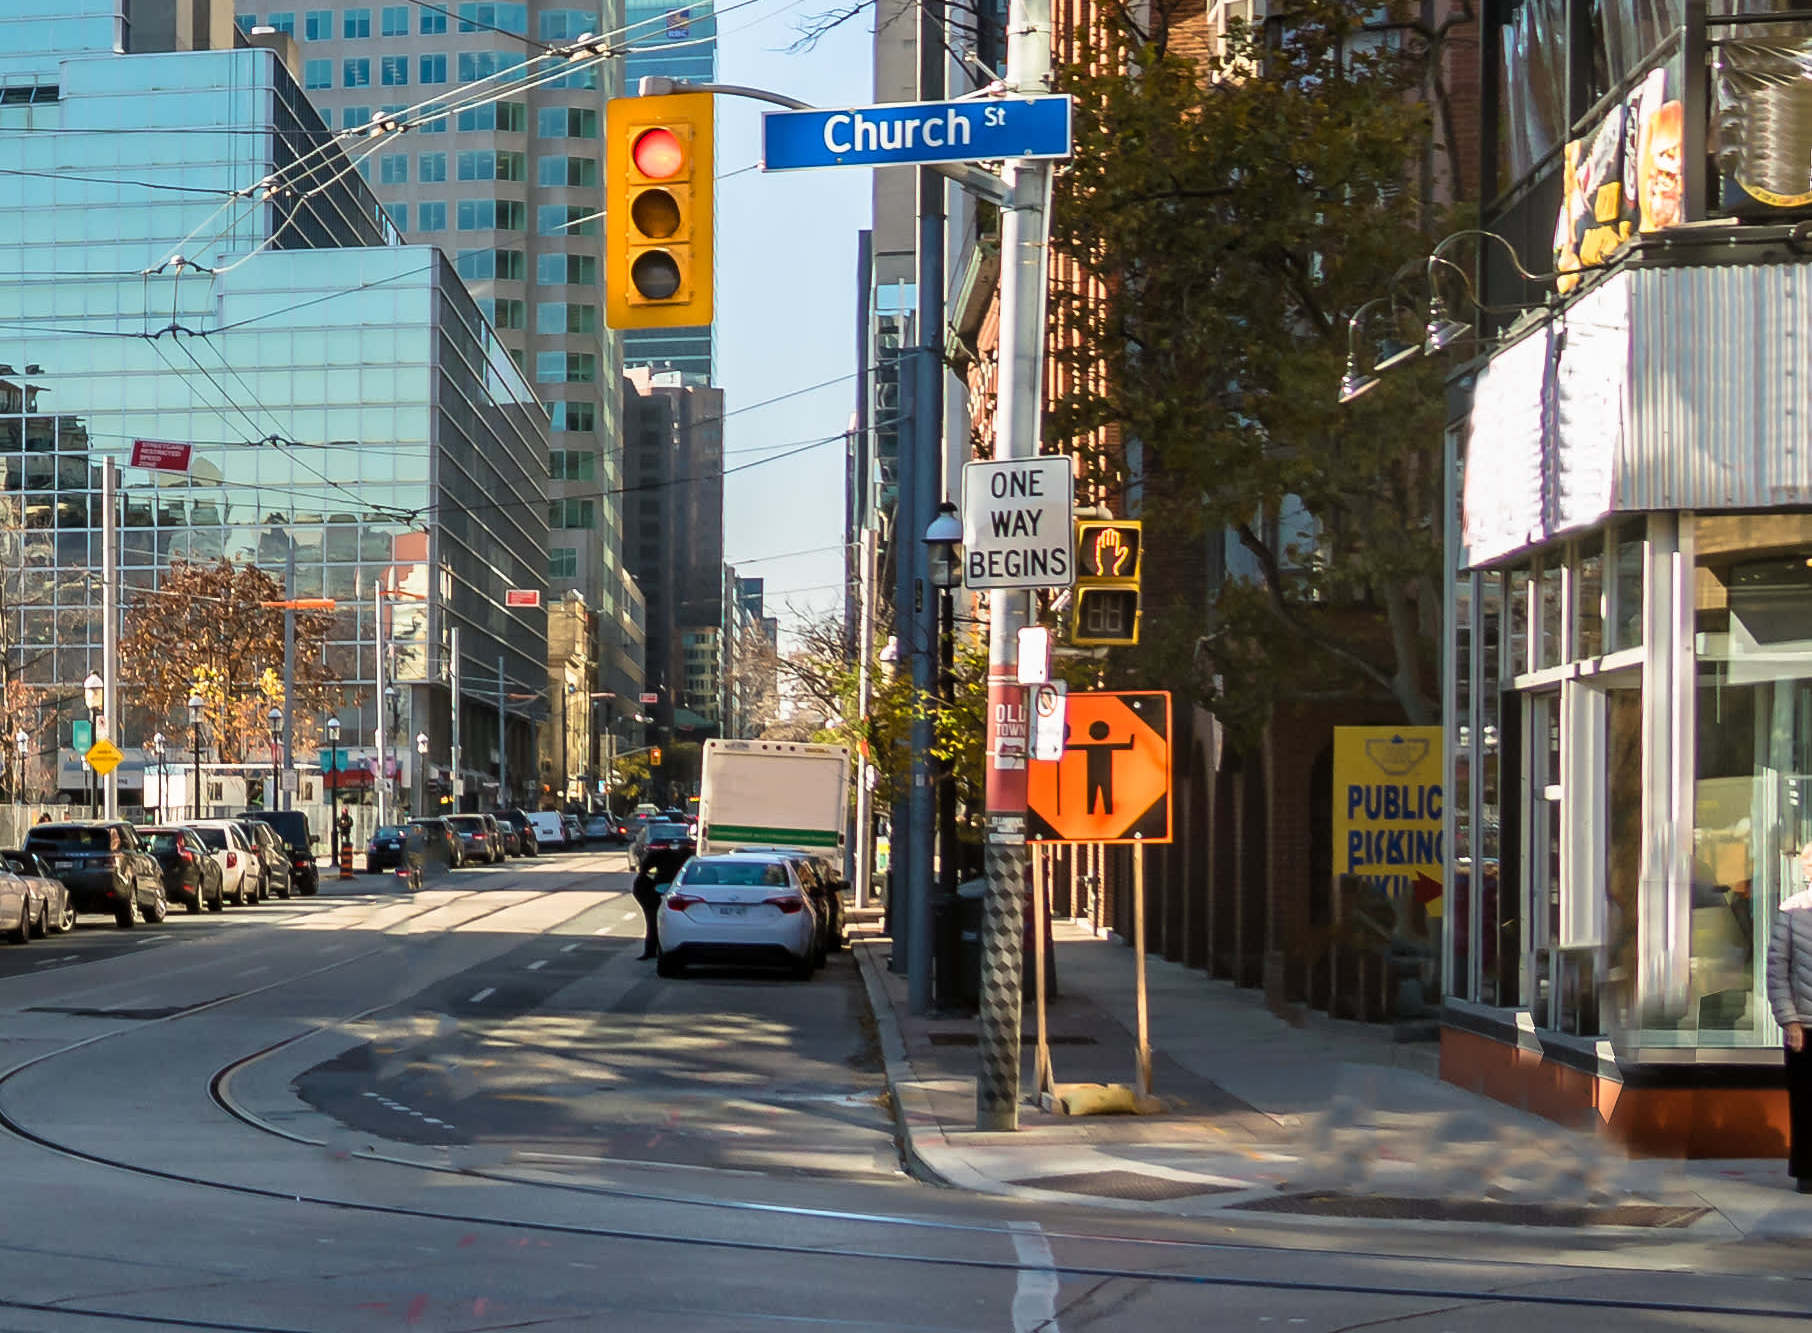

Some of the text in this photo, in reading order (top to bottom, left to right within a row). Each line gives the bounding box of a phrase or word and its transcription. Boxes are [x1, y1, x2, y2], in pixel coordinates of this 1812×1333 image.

[823, 107, 1006, 153] Church St
[990, 469, 1044, 499] ONE
[990, 508, 1044, 538] WAY
[969, 547, 1067, 579] BEGINS
[1347, 784, 1443, 821] PUBLIC
